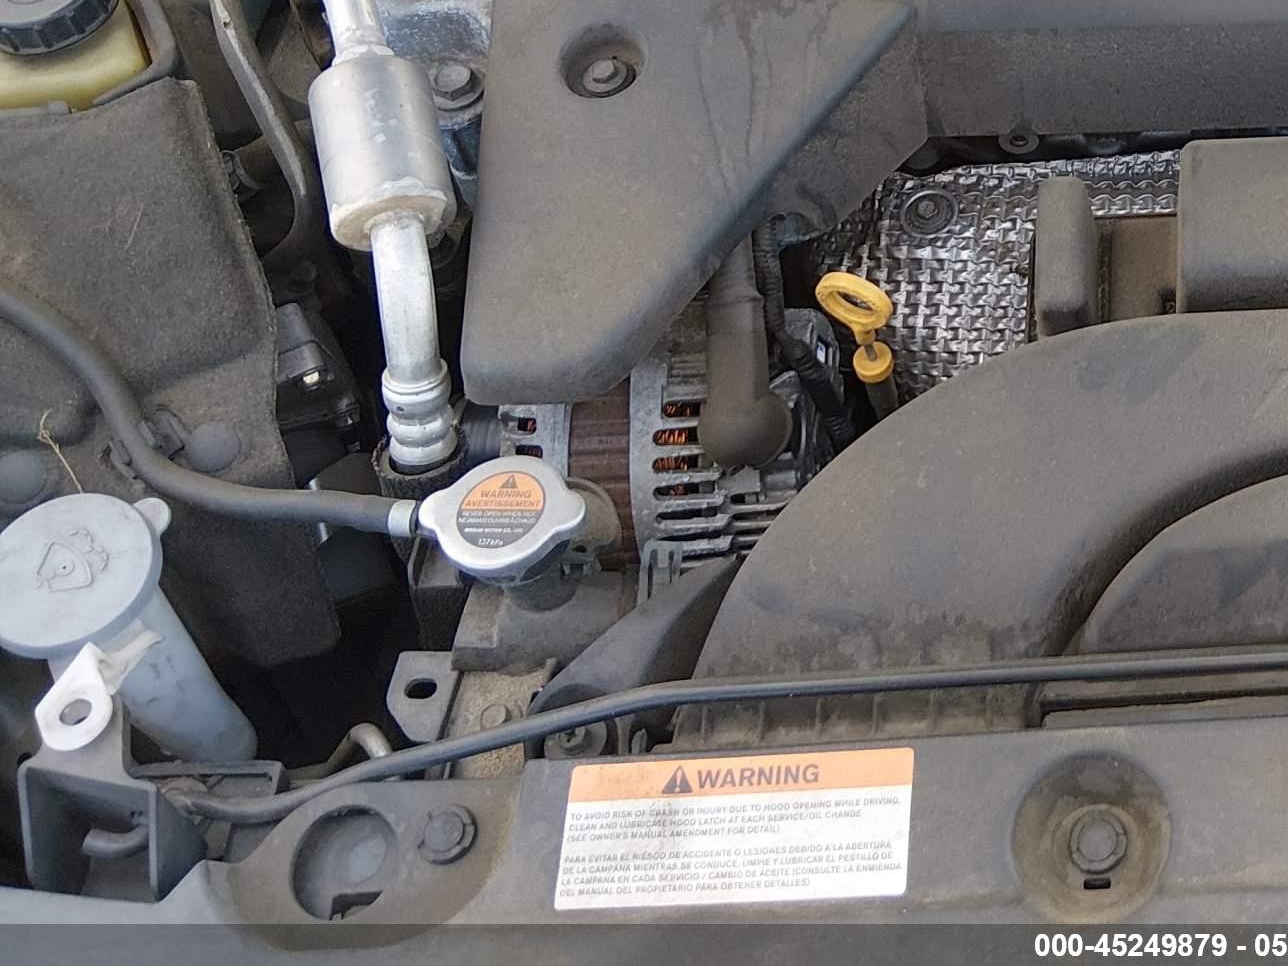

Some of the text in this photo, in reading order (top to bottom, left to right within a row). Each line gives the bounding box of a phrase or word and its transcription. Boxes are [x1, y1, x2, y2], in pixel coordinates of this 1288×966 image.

[465, 499, 540, 507] AVERTISSEMENT
[481, 489, 532, 498] WARNING
[697, 763, 819, 789] WARNING
[569, 823, 597, 831] CLEAN
[600, 821, 617, 829] AND
[620, 819, 668, 828] LUBRICATE
[670, 818, 696, 827] HOOD
[699, 816, 727, 825] LATCH
[729, 815, 738, 823] AT
[741, 814, 765, 823] EACH
[825, 809, 861, 819] CHANGE
[572, 813, 582, 821] TO
[584, 812, 610, 820] AVOID
[613, 810, 632, 819] RISK
[635, 810, 646, 818] OF
[682, 807, 694, 816] OR
[697, 806, 726, 815] INJURY
[729, 805, 747, 813] DUE
[751, 804, 761, 812] TO
[764, 802, 790, 811] HOOD
[793, 800, 831, 809] OPENING
[834, 798, 859, 807] WHILE
[631, 830, 667, 840] MANUAL
[670, 828, 726, 838] AMENDMENT
[728, 826, 745, 835] FOR
[563, 866, 575, 875] DE
[577, 865, 586, 874] LA
[634, 861, 677, 871] MIENTRAS
[681, 861, 692, 869] SE
[780, 855, 823, 865] LUBRICAR
[826, 854, 835, 863] EL
[838, 852, 879, 862] PESTILLO
[881, 851, 893, 859] DE
[565, 855, 586, 864] PARA
[589, 853, 618, 862] EVITAR
[620, 853, 629, 861] EL
[669, 851, 681, 859] DE
[682, 848, 731, 858] ACCIDENTE
[743, 846, 787, 855] LESIONES
[789, 844, 822, 854] DEBIDO
[845, 841, 891, 850] ABERTURA
[561, 876, 571, 885] LA
[618, 874, 629, 882] EN
[631, 872, 656, 882] CADA
[659, 870, 699, 880] SERVICIO
[708, 869, 743, 879] CAMBIO
[745, 869, 757, 878] DE
[760, 866, 789, 877] ACEITE
[843, 864, 854, 873] LA
[856, 862, 901, 872] ENMIENDA
[559, 889, 575, 897] DEL
[578, 886, 614, 896] MANUAL
[616, 885, 632, 894] DEL
[636, 882, 693, 893] PROPIETARIO
